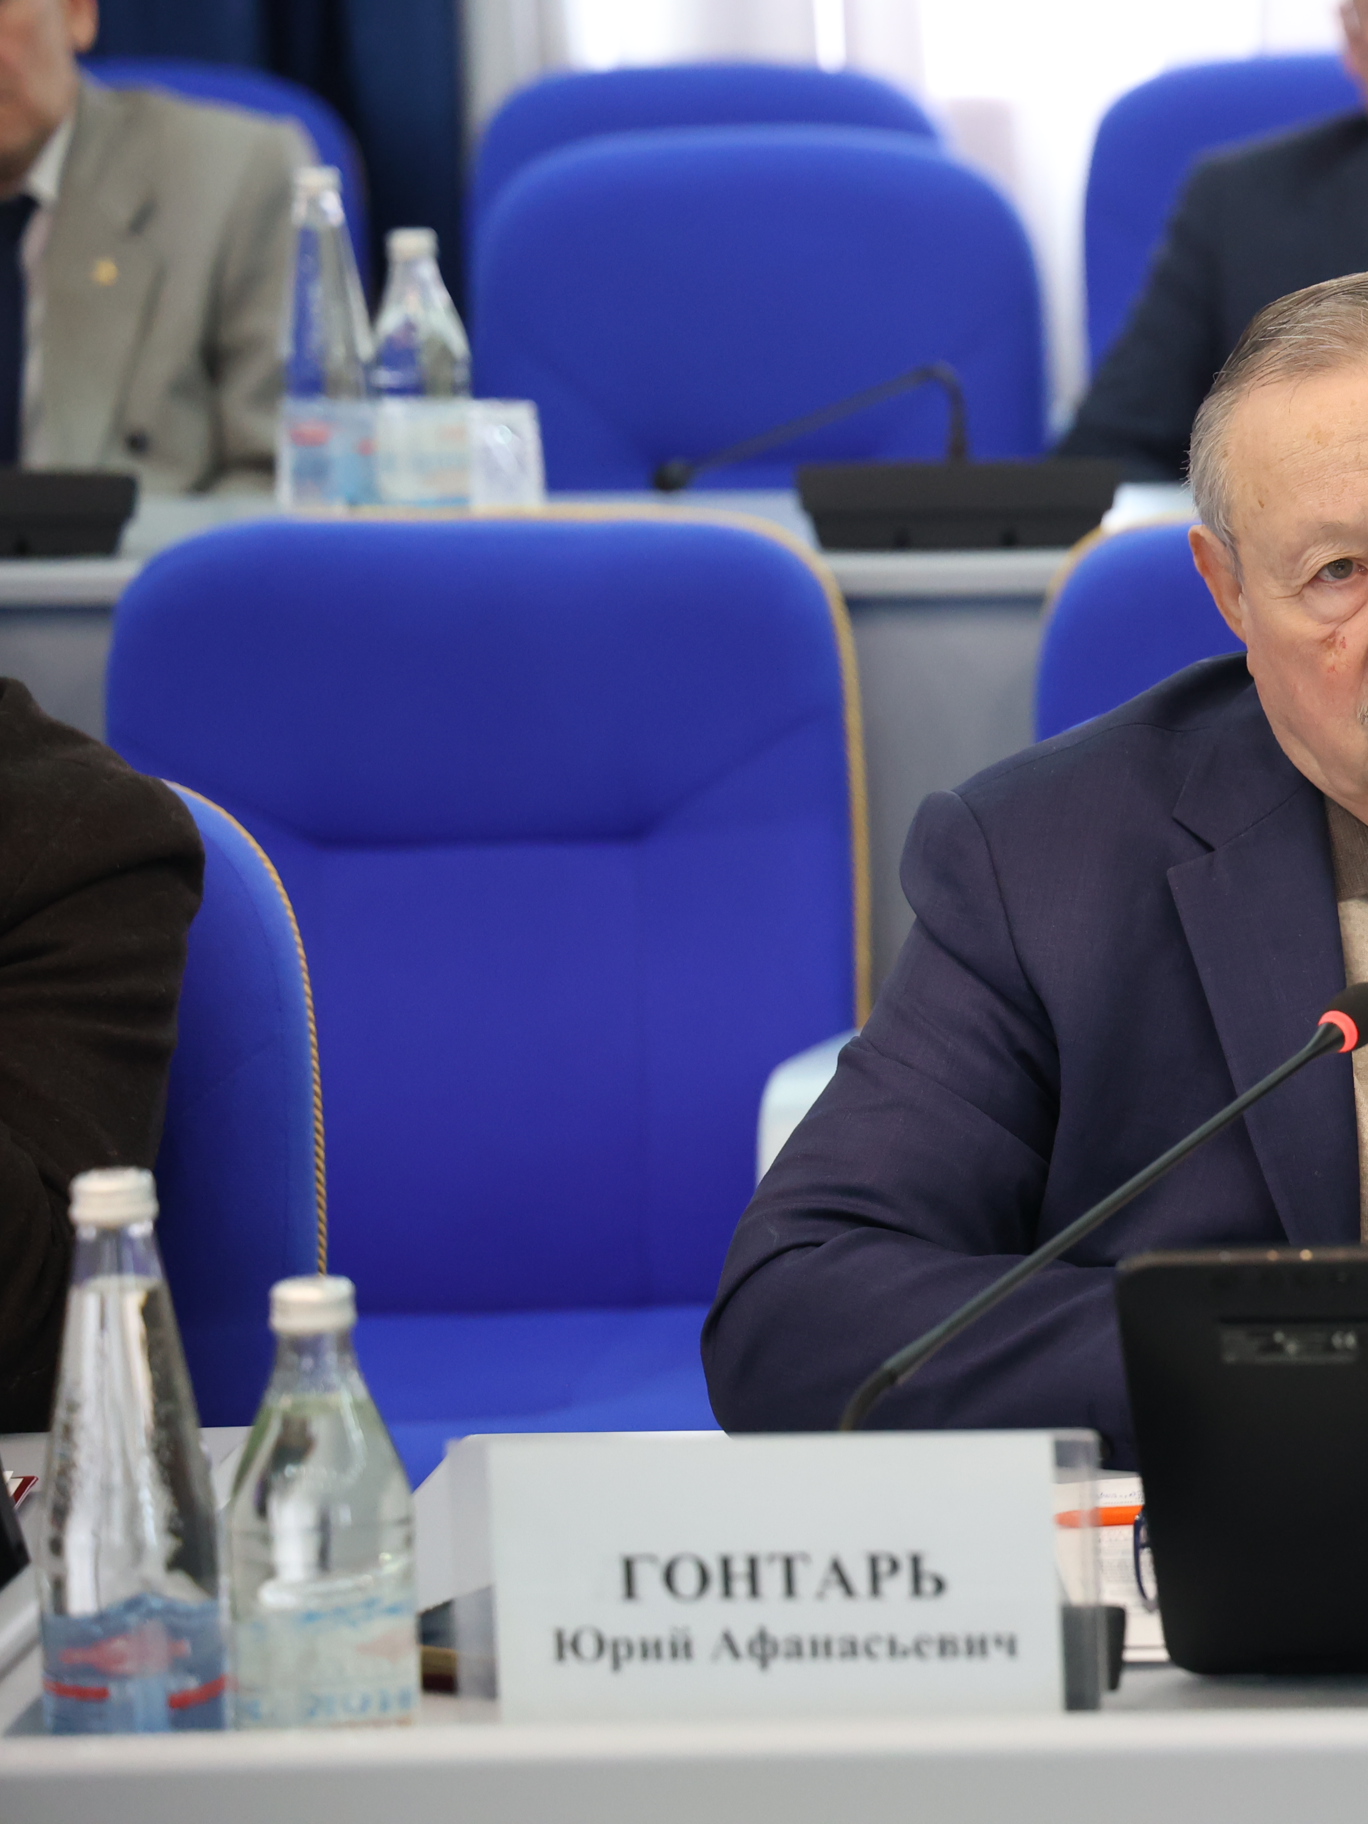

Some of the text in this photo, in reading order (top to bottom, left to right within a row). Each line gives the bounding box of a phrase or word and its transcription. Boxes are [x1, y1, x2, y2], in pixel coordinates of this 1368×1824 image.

[620, 1551, 948, 1602] ГОНТАРЬ
[554, 1624, 1017, 1673] Юрий Афанасьевич
